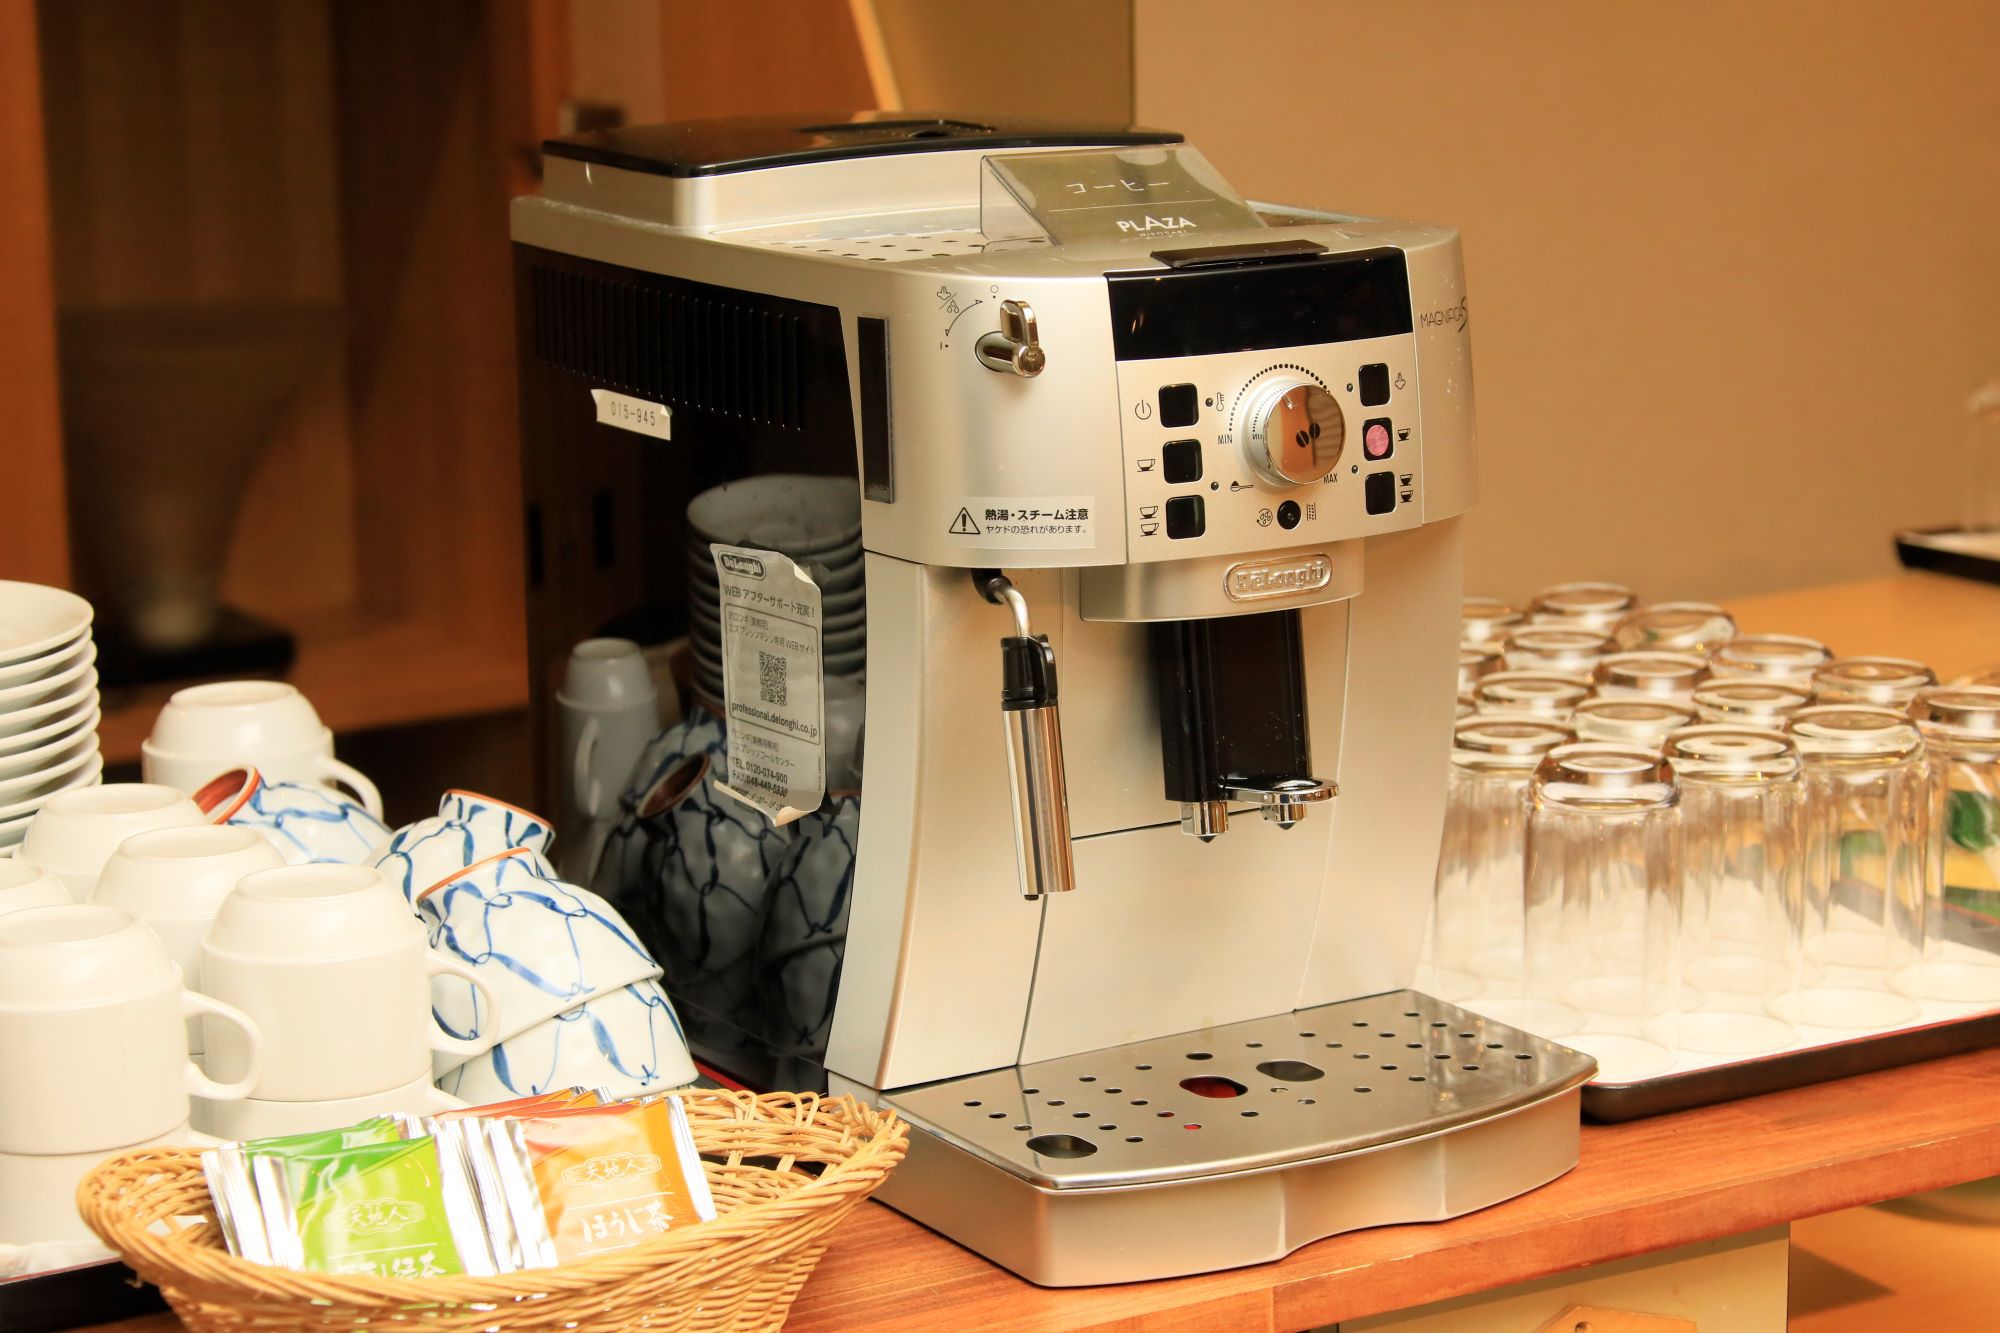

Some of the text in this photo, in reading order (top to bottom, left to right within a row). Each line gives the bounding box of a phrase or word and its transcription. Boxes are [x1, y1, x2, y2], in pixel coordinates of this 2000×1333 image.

[1065, 179, 1170, 194] コーヒー
[1116, 215, 1197, 233] PLAZA
[610, 401, 656, 426] 015-945
[1218, 434, 1233, 445] MIN
[1323, 473, 1338, 484] MAX
[985, 508, 1089, 521] 熱湯・スチーム注意
[985, 524, 1087, 535] ヤケドの恐れがあります。
[724, 584, 741, 598] WEB
[731, 702, 818, 738] professional.delonghi.co.jp
[581, 1200, 674, 1243] ほうじ茶
